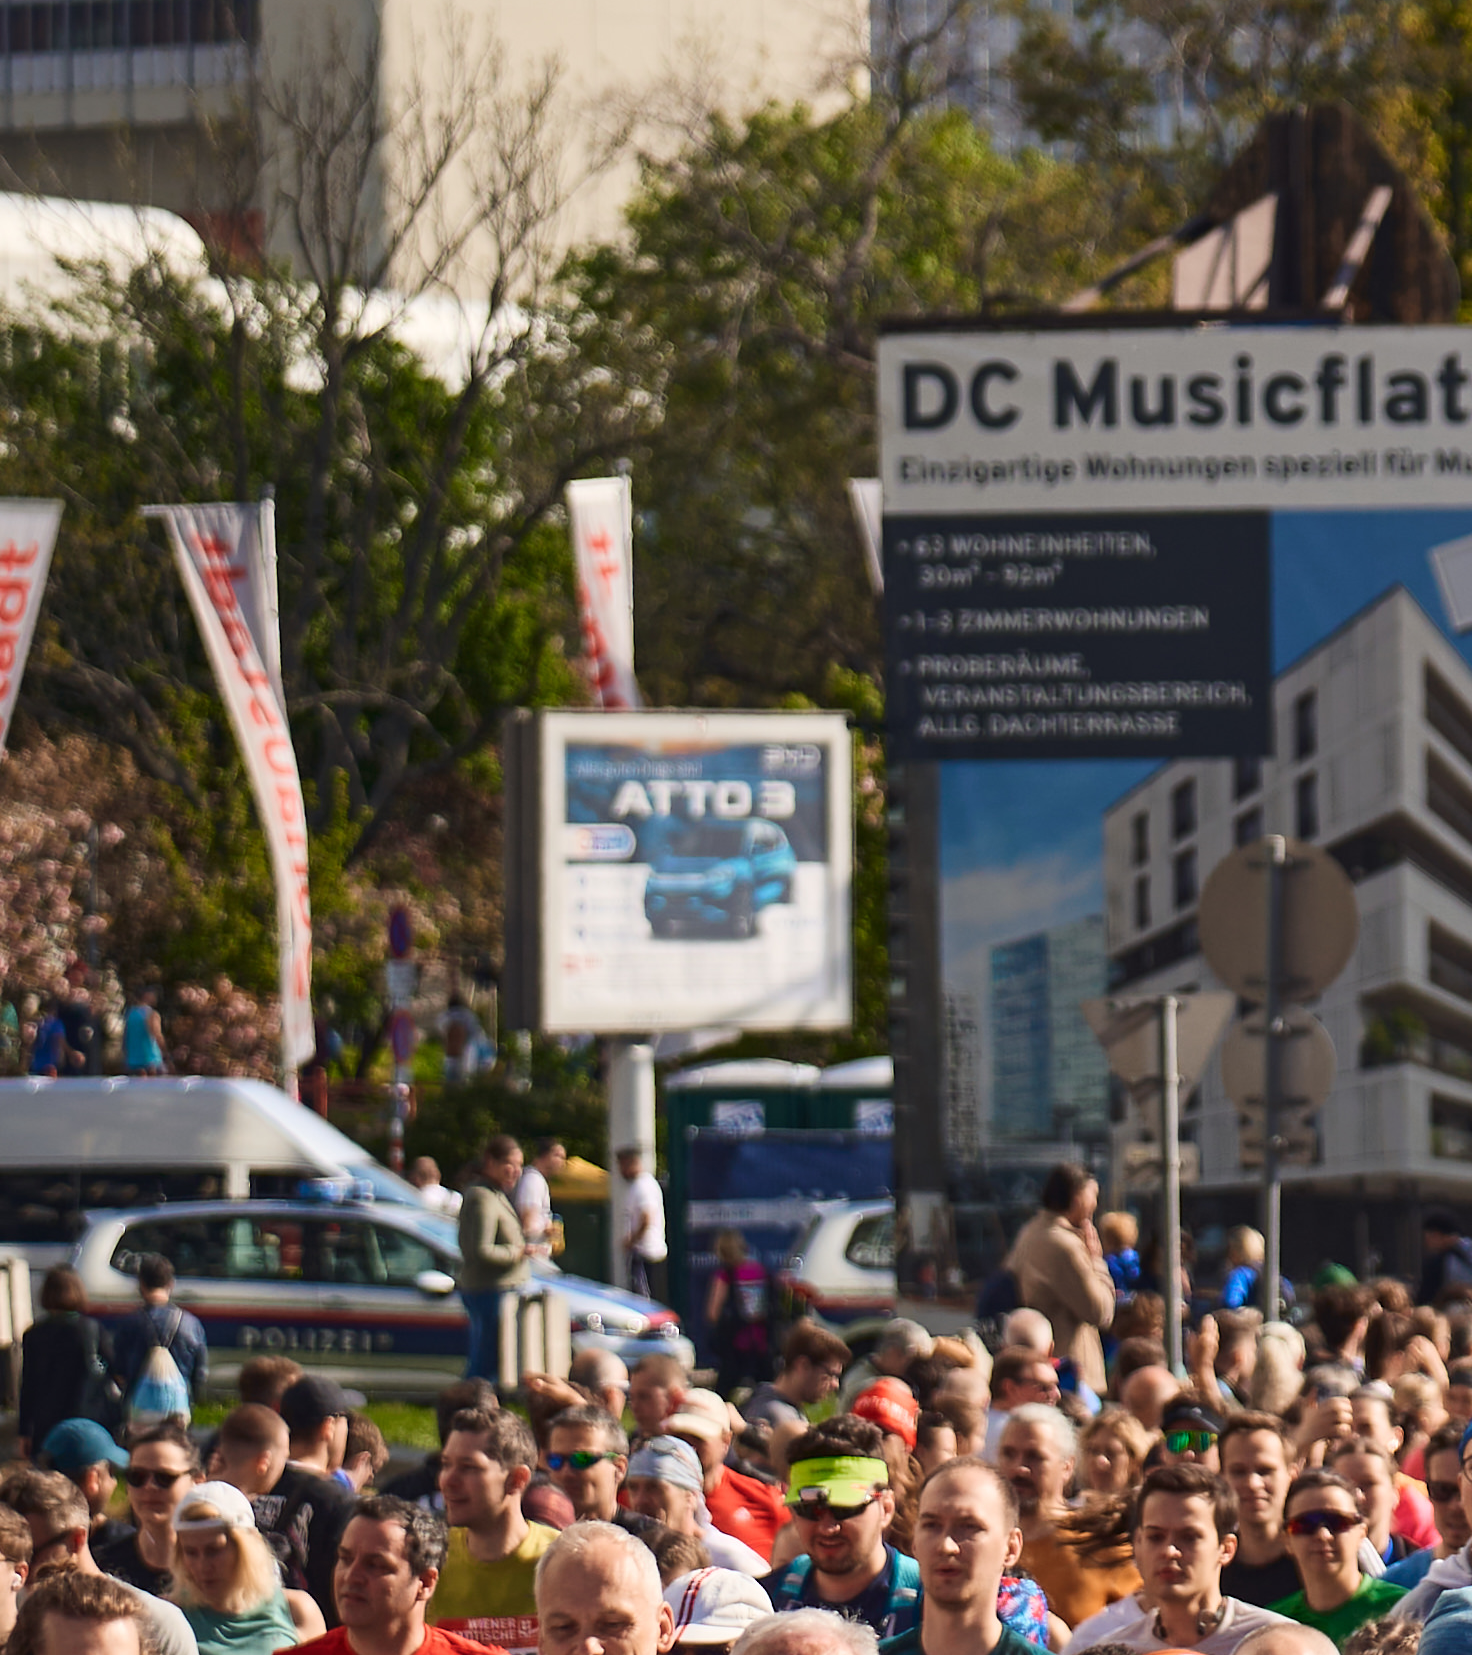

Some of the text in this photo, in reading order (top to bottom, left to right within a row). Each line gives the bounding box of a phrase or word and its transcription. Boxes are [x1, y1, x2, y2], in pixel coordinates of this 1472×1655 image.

[902, 358, 1020, 432] DC
[900, 455, 1075, 485] Einzigartige
[1086, 452, 1255, 484] Wohnungen
[1266, 447, 1377, 480] speziell
[1385, 446, 1429, 476] für
[960, 606, 1210, 630] ZIMMERWOHNUNGEN
[610, 779, 797, 819] ATTO 3
[239, 1326, 373, 1352] POLIZEI
[467, 1617, 517, 1631] WIENER
